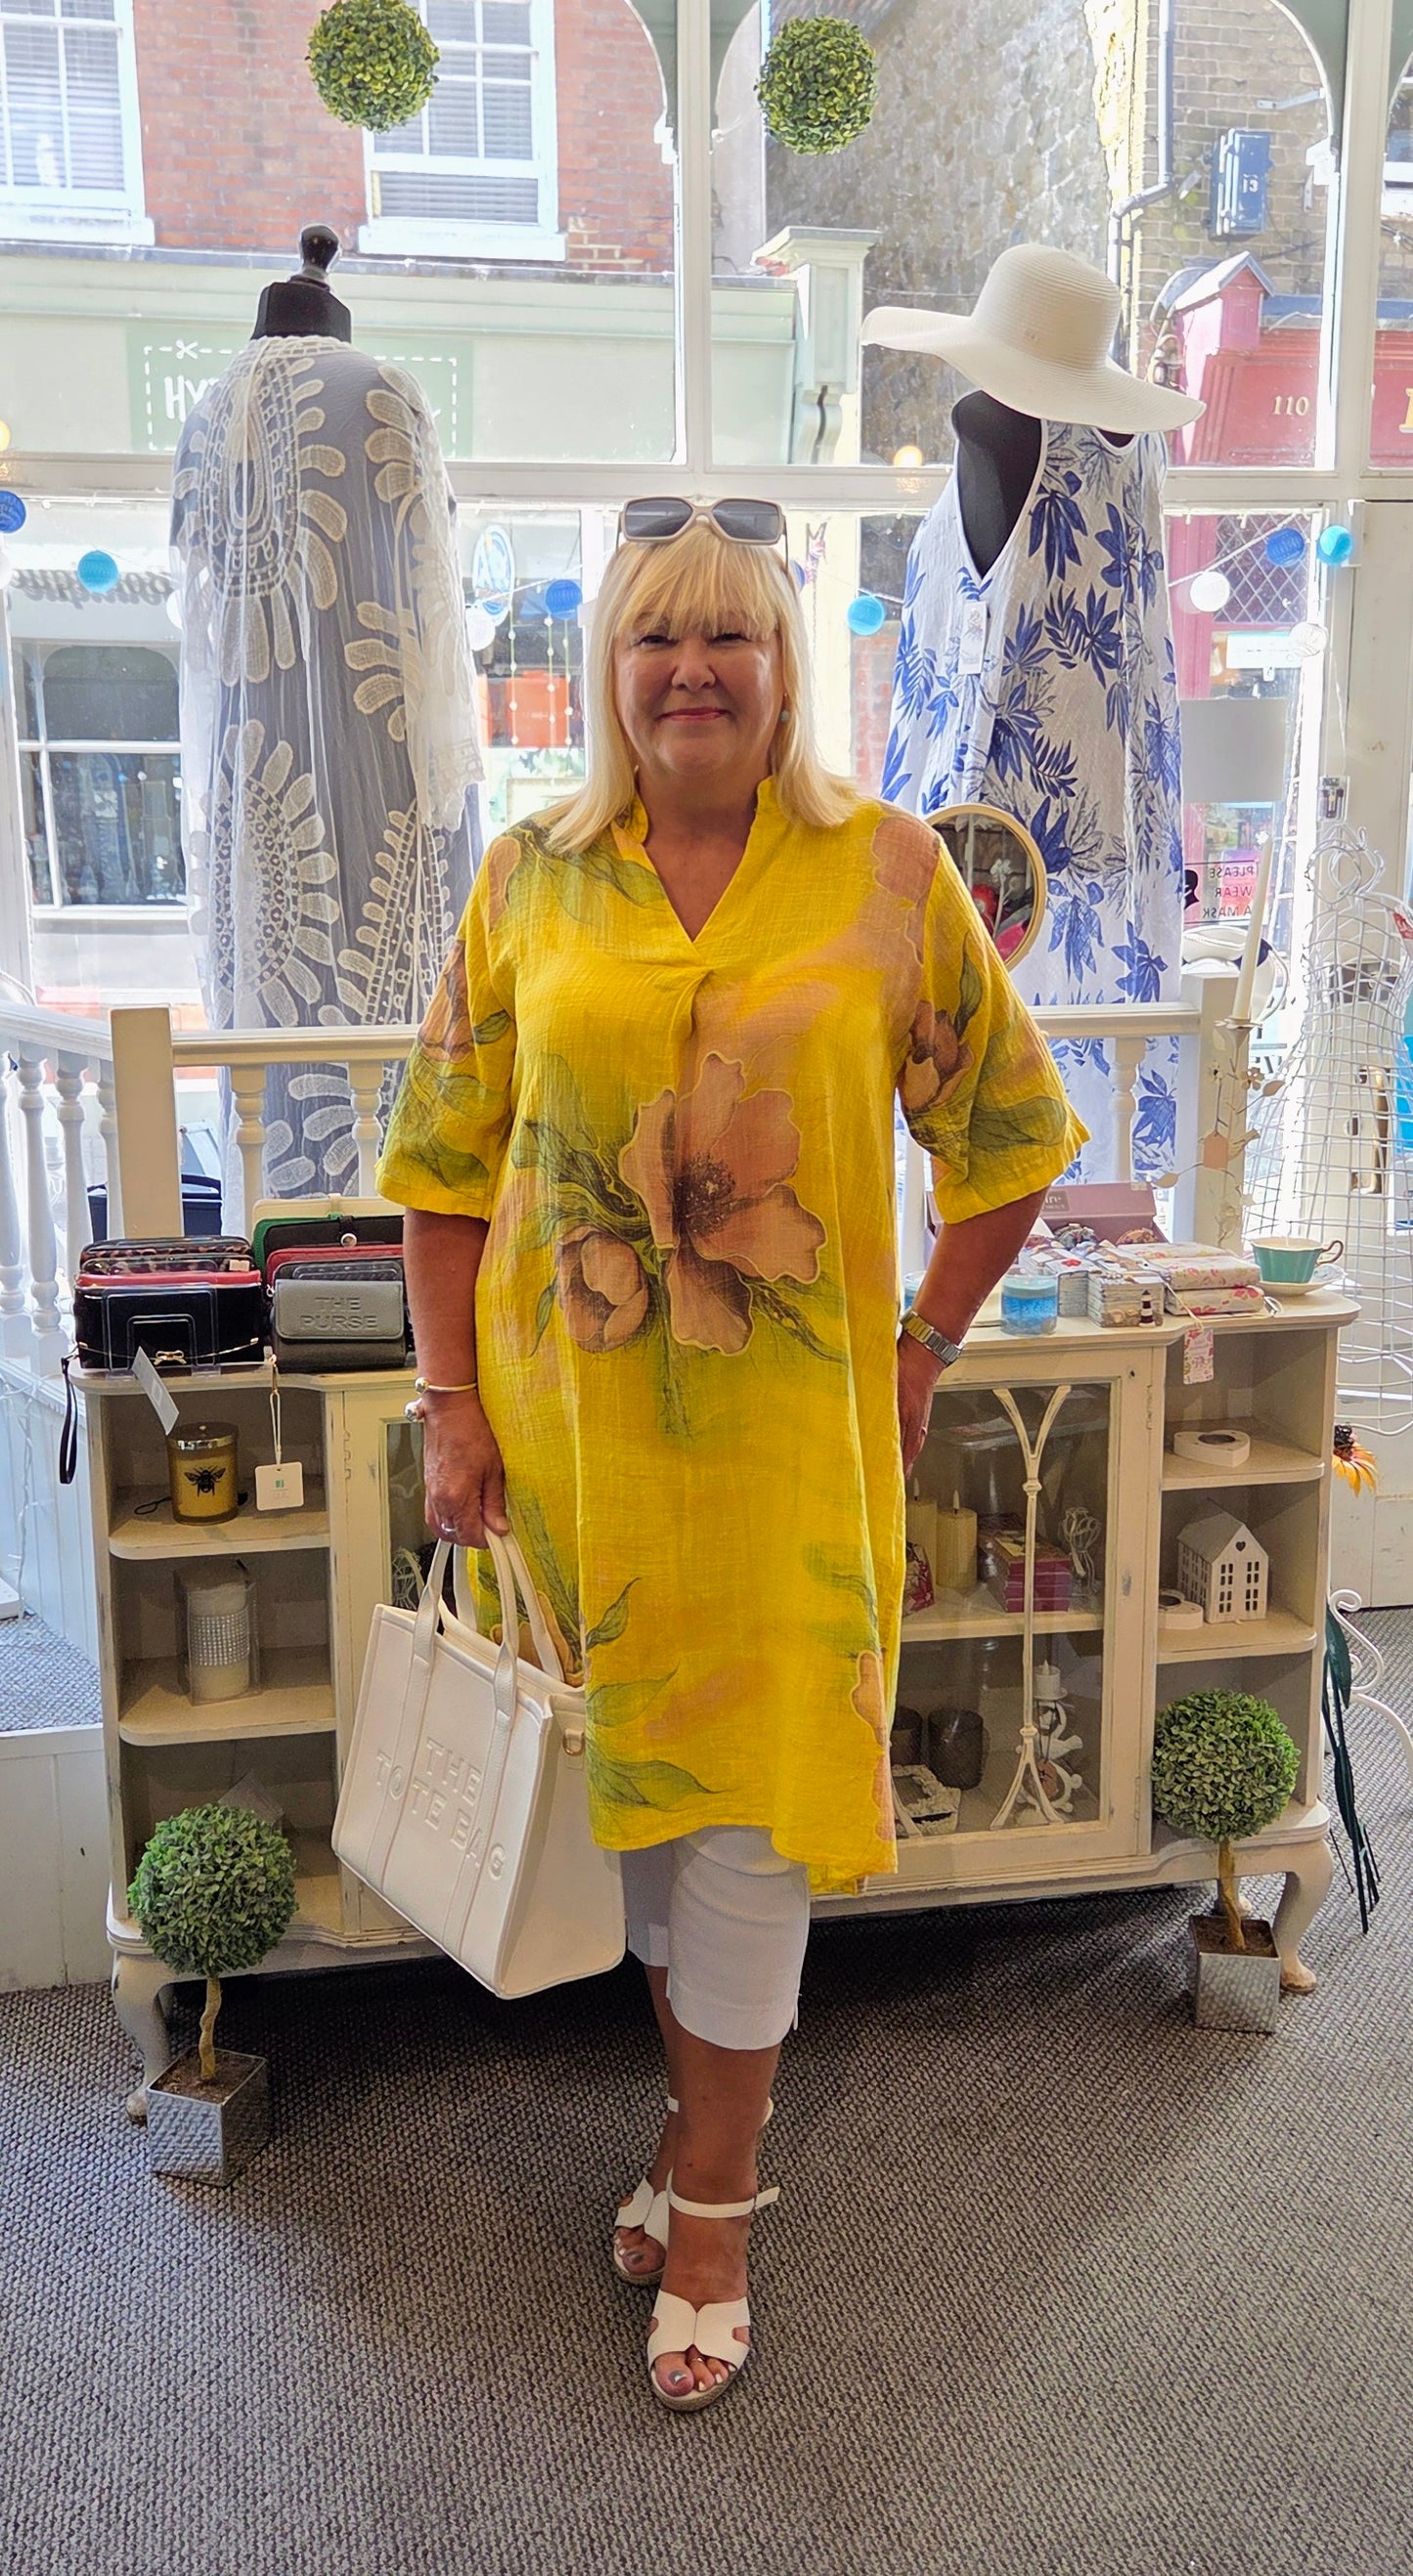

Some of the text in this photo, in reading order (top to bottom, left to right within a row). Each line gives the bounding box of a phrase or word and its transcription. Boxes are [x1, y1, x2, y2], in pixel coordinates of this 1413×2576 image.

[1273, 395, 1309, 417] 110
[314, 1296, 361, 1312] THE
[299, 1313, 378, 1330] PURSE
[424, 1736, 482, 1806] THE
[450, 1807, 508, 1882] BAG
